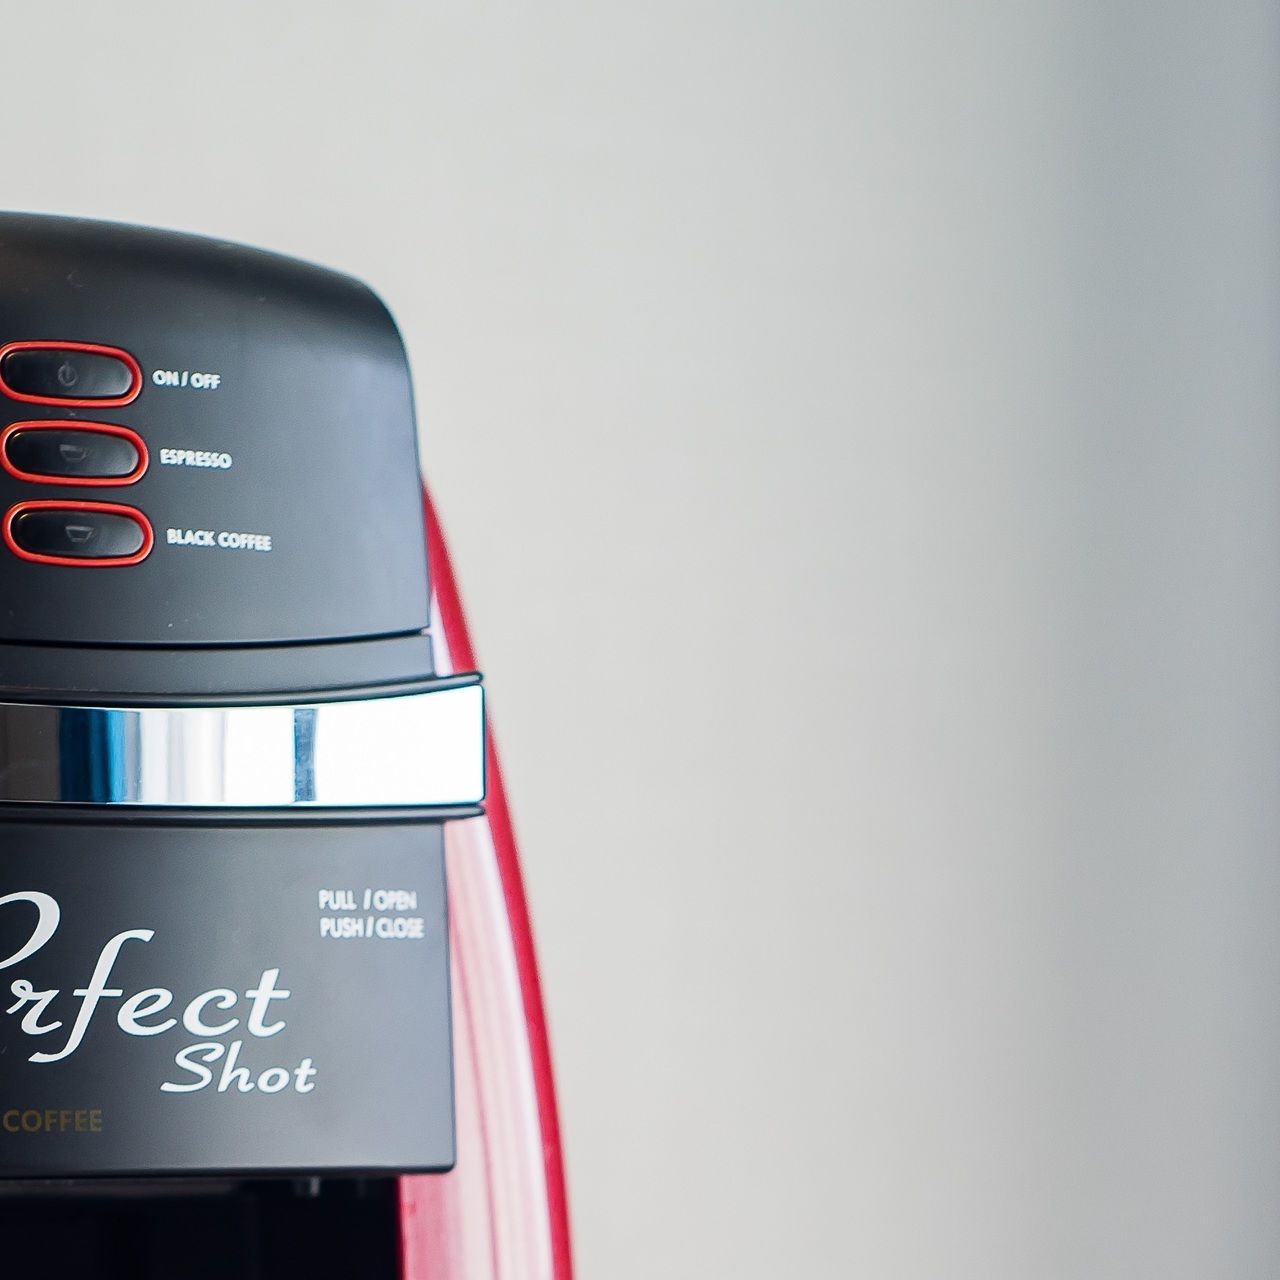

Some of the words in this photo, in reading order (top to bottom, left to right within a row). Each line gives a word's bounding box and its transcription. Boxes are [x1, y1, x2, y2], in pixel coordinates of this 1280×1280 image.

[152, 370, 179, 386] ON
[190, 372, 221, 389] OFF
[160, 449, 233, 469] ESPRESSO
[166, 528, 216, 547] BLACK
[217, 532, 272, 551] COFFEE
[318, 889, 358, 911] PULL
[373, 889, 418, 911] OPEN
[320, 917, 365, 938] PUSH
[375, 917, 425, 939] CLOSE
[160, 1039, 317, 1093] Shot
[3, 1109, 103, 1133] COFFEE
